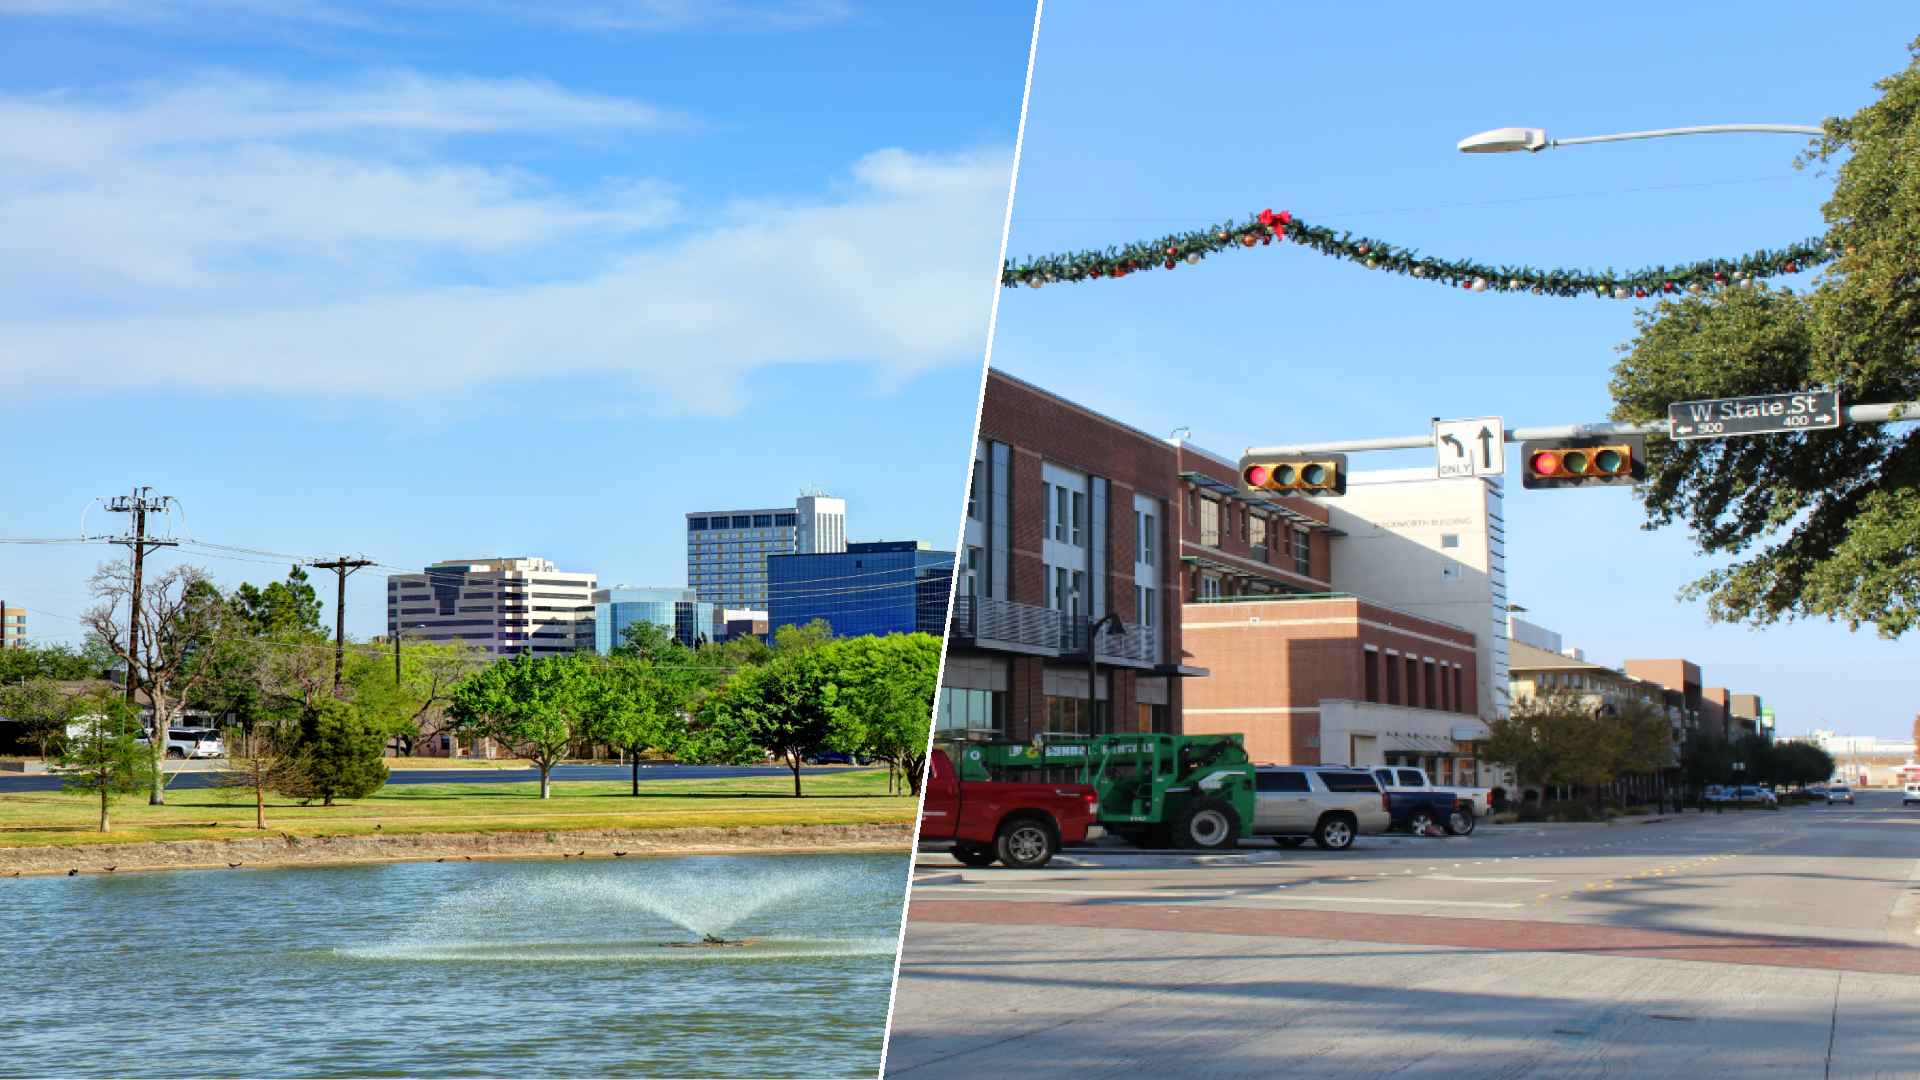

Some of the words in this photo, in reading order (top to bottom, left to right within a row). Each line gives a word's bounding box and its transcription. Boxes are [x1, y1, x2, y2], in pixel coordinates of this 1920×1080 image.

[1690, 404, 1712, 422] W
[1720, 402, 1784, 420] State
[1783, 415, 1809, 426] 400
[1698, 422, 1723, 433] 500
[1440, 463, 1472, 475] ONLY
